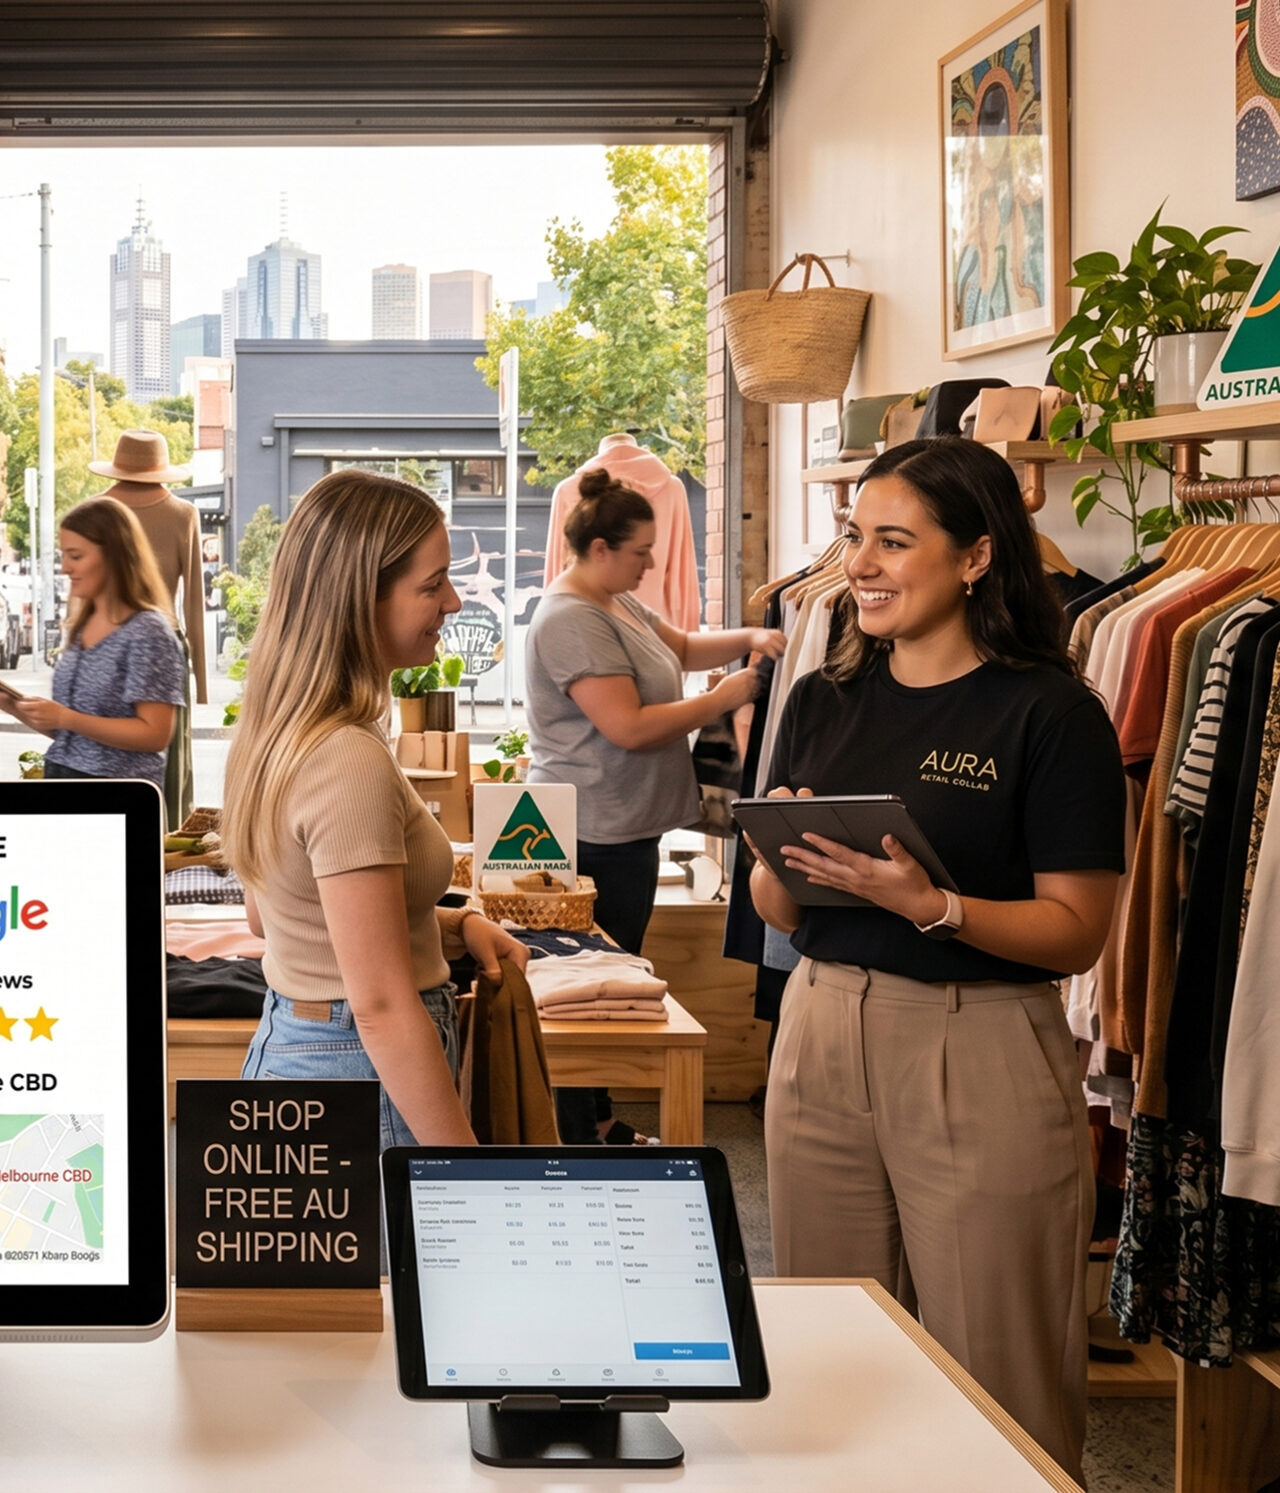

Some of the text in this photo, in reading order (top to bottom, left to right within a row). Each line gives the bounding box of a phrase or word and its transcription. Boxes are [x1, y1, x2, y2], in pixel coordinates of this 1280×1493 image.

[920, 750, 998, 781] AURA
[920, 774, 990, 791] RETAIL COLLAB
[482, 861, 541, 871] AUSTRALIAN
[10, 1074, 57, 1091] CBD
[230, 1100, 324, 1130] SHOP
[204, 1144, 329, 1174] ONLINE
[63, 1170, 92, 1182] CBD
[206, 1188, 348, 1219] FREE AU
[197, 1231, 358, 1262] SHIPPING
